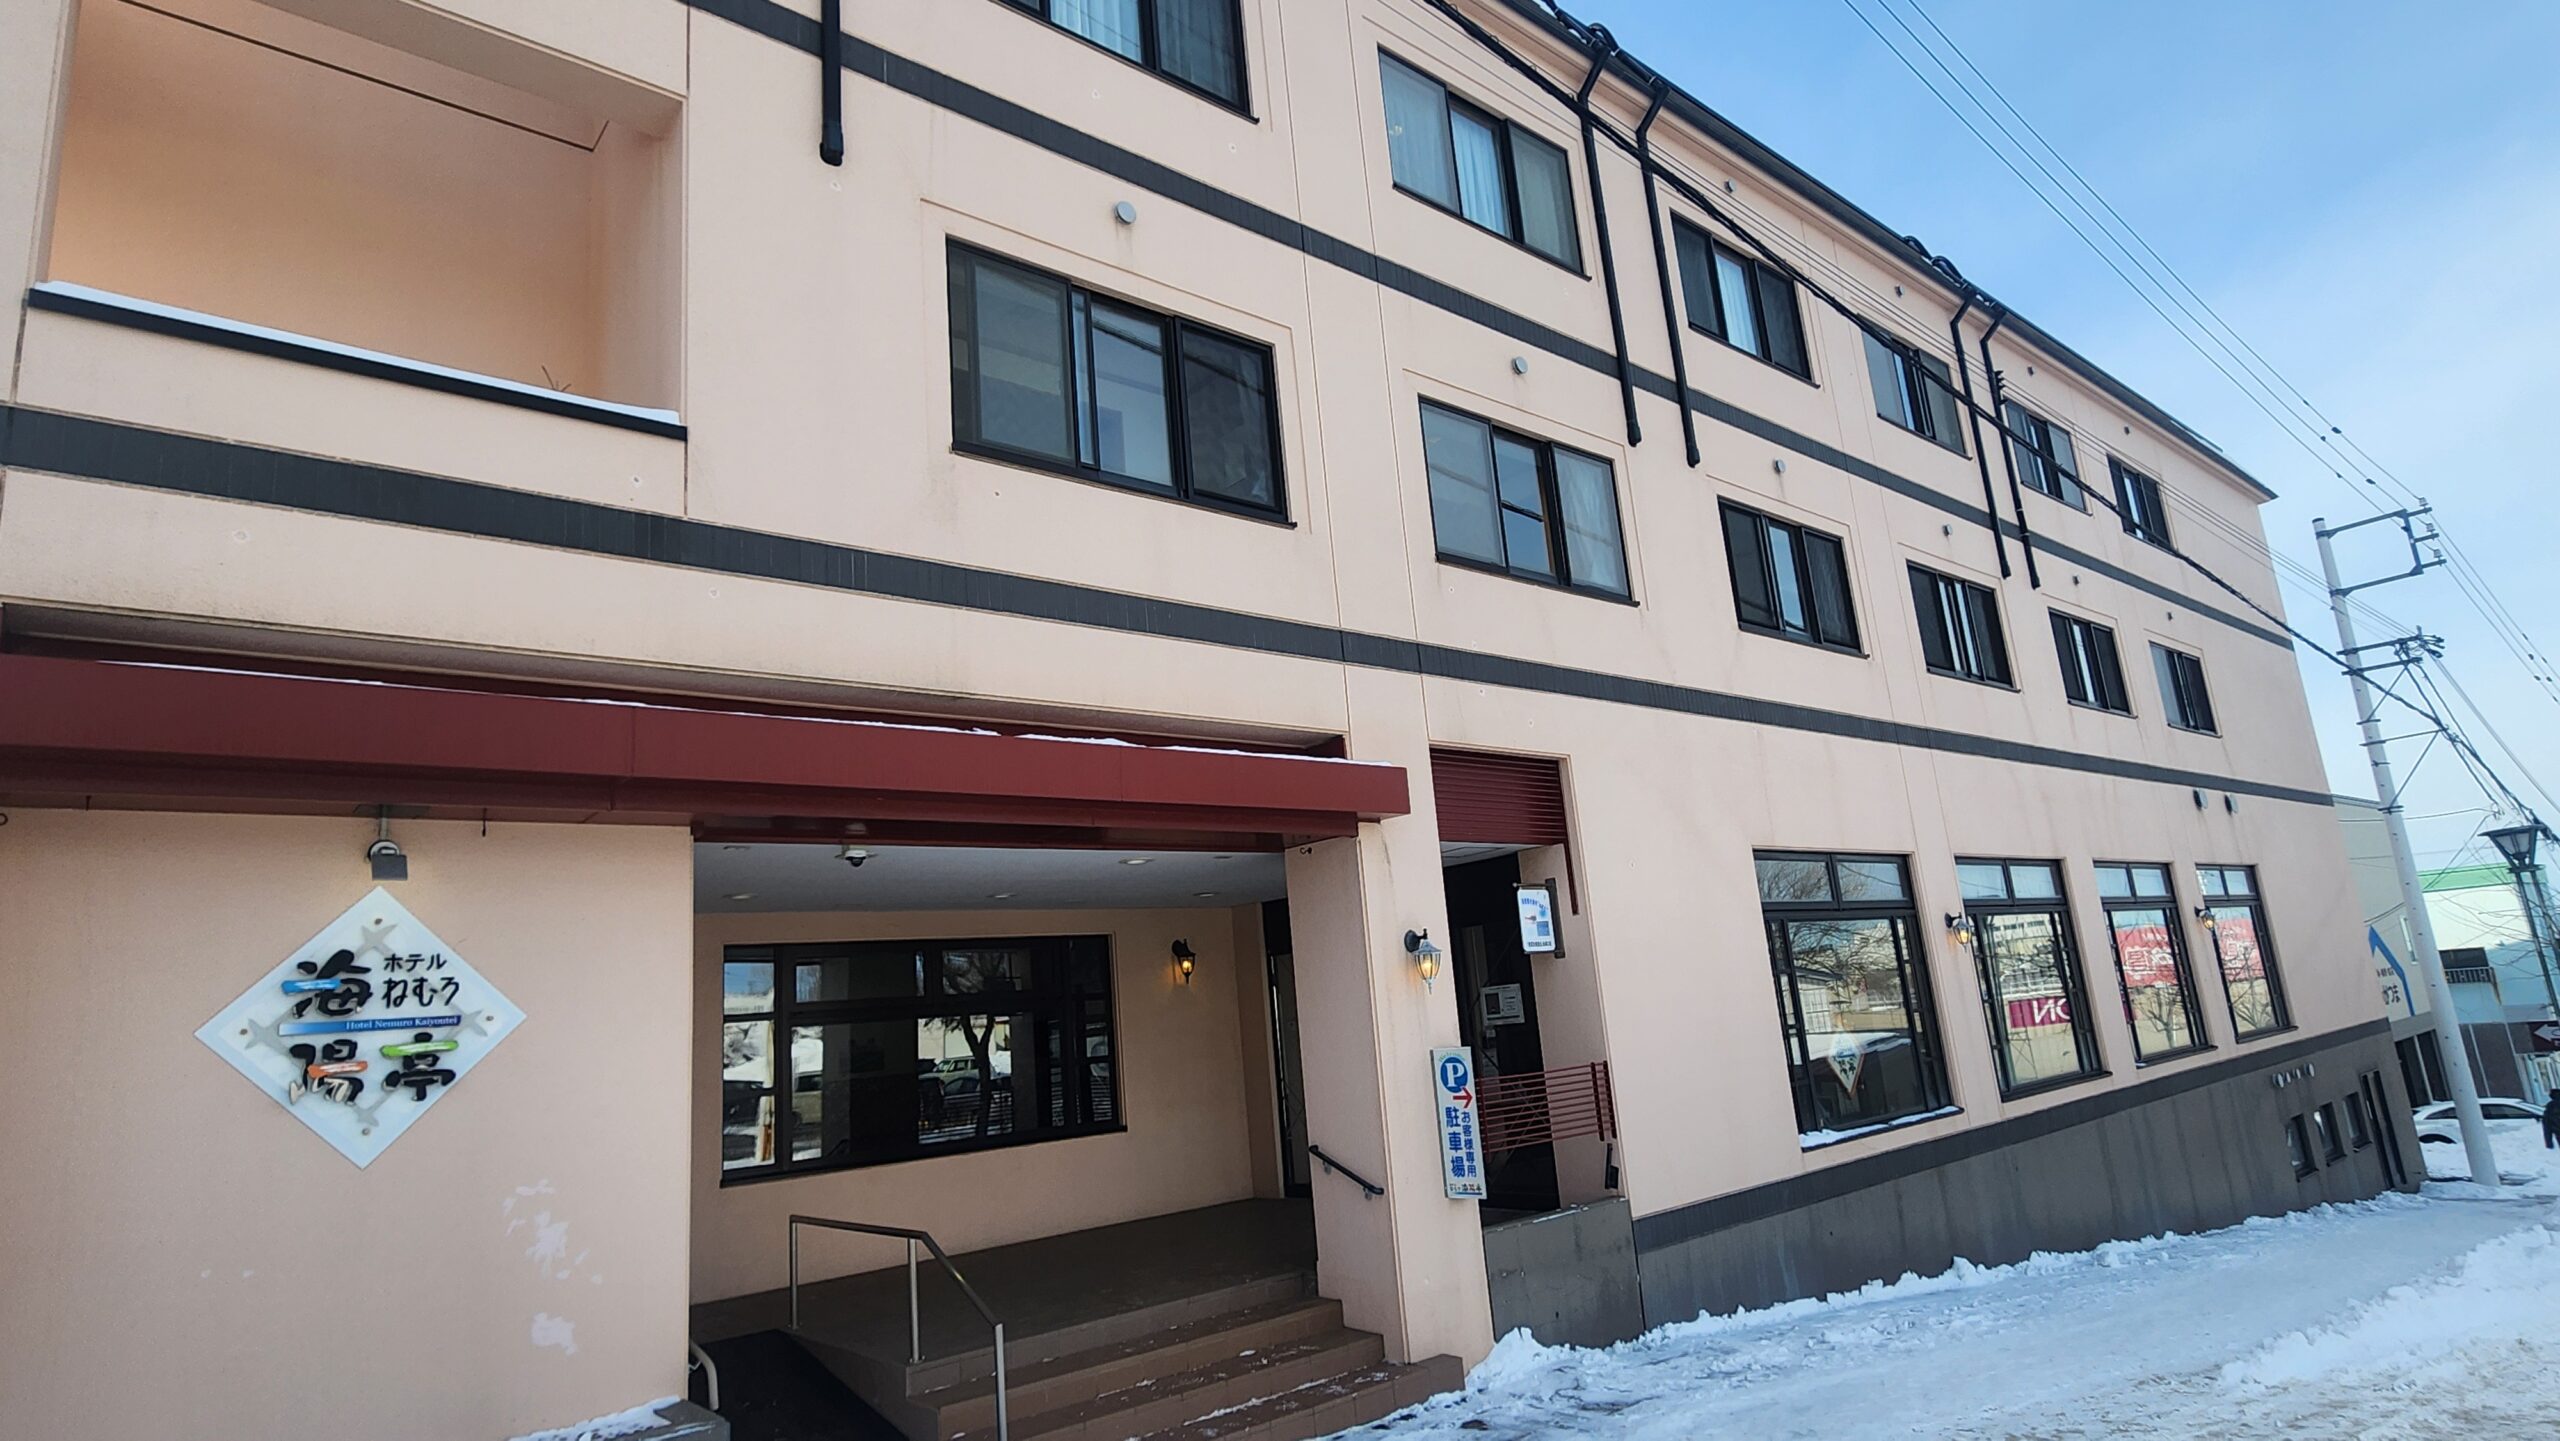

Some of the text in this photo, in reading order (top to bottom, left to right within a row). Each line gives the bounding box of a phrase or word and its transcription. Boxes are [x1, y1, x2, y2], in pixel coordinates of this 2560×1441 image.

[383, 953, 447, 973] ホテル
[382, 976, 460, 1009] ねむろ
[346, 1016, 458, 1030] Hotel Nemuro Kaiyoutei
[1445, 1062, 1465, 1088] P
[1445, 1106, 1466, 1178] 駐車場
[1461, 1111, 1477, 1178] お客様専用
